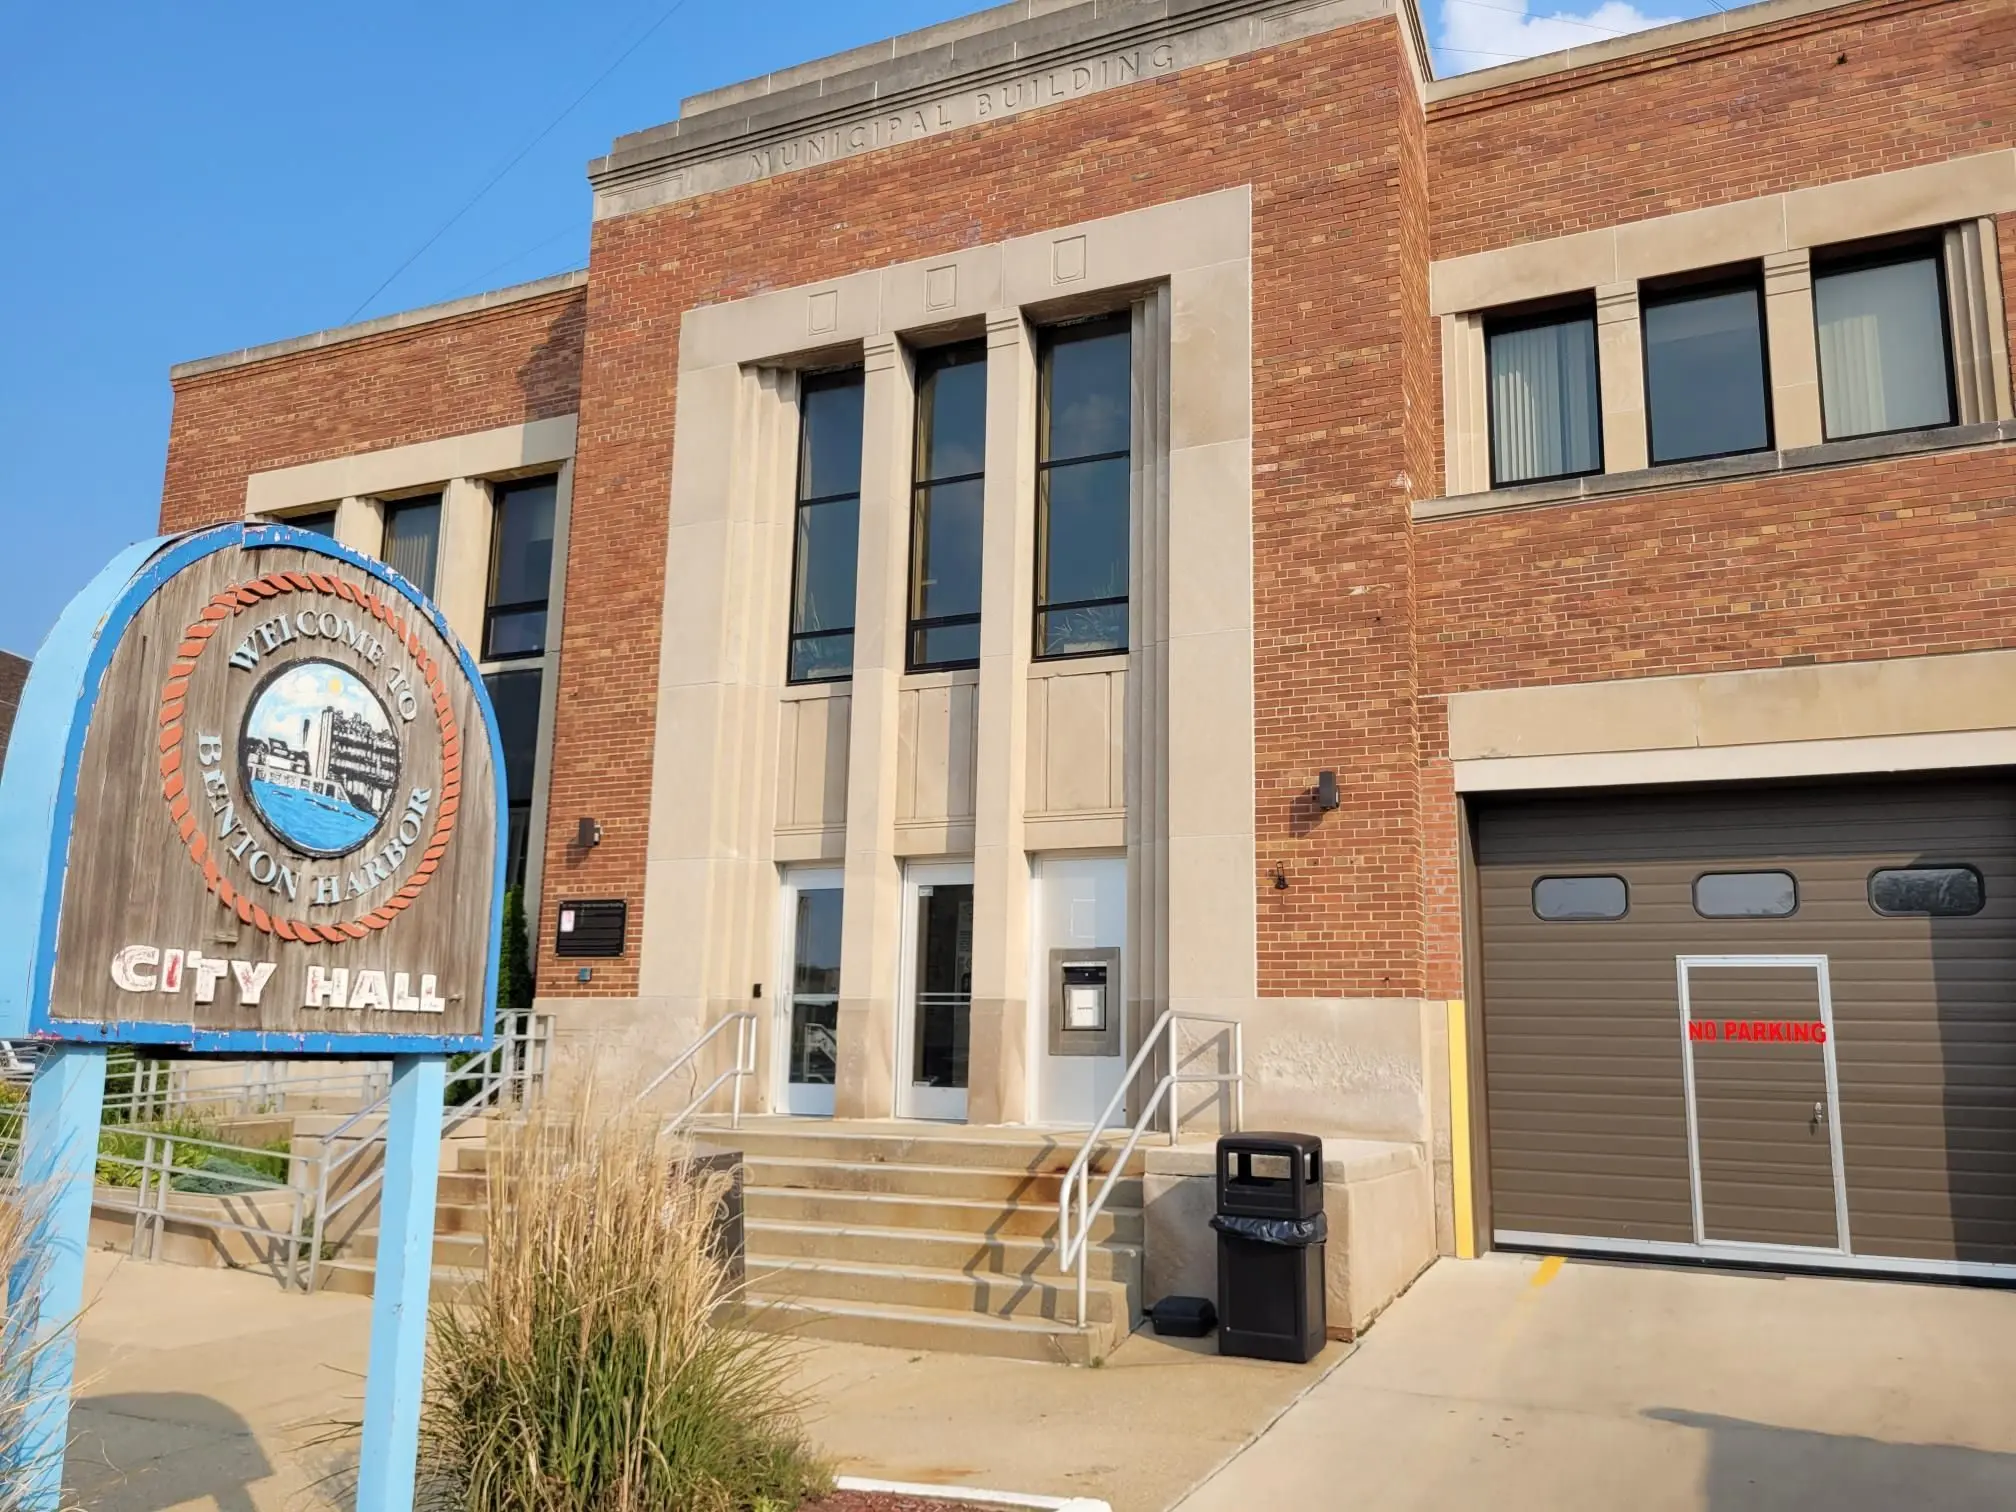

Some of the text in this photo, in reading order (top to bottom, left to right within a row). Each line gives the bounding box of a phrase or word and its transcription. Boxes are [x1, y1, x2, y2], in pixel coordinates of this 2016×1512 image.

[748, 44, 1174, 179] MUNICIPAL BUILDING
[229, 609, 417, 722] WELCOME TO
[197, 732, 432, 906] BENTON HARBOR
[111, 944, 446, 1012] CITY HALL
[1688, 1020, 1827, 1043] NO PARKING
